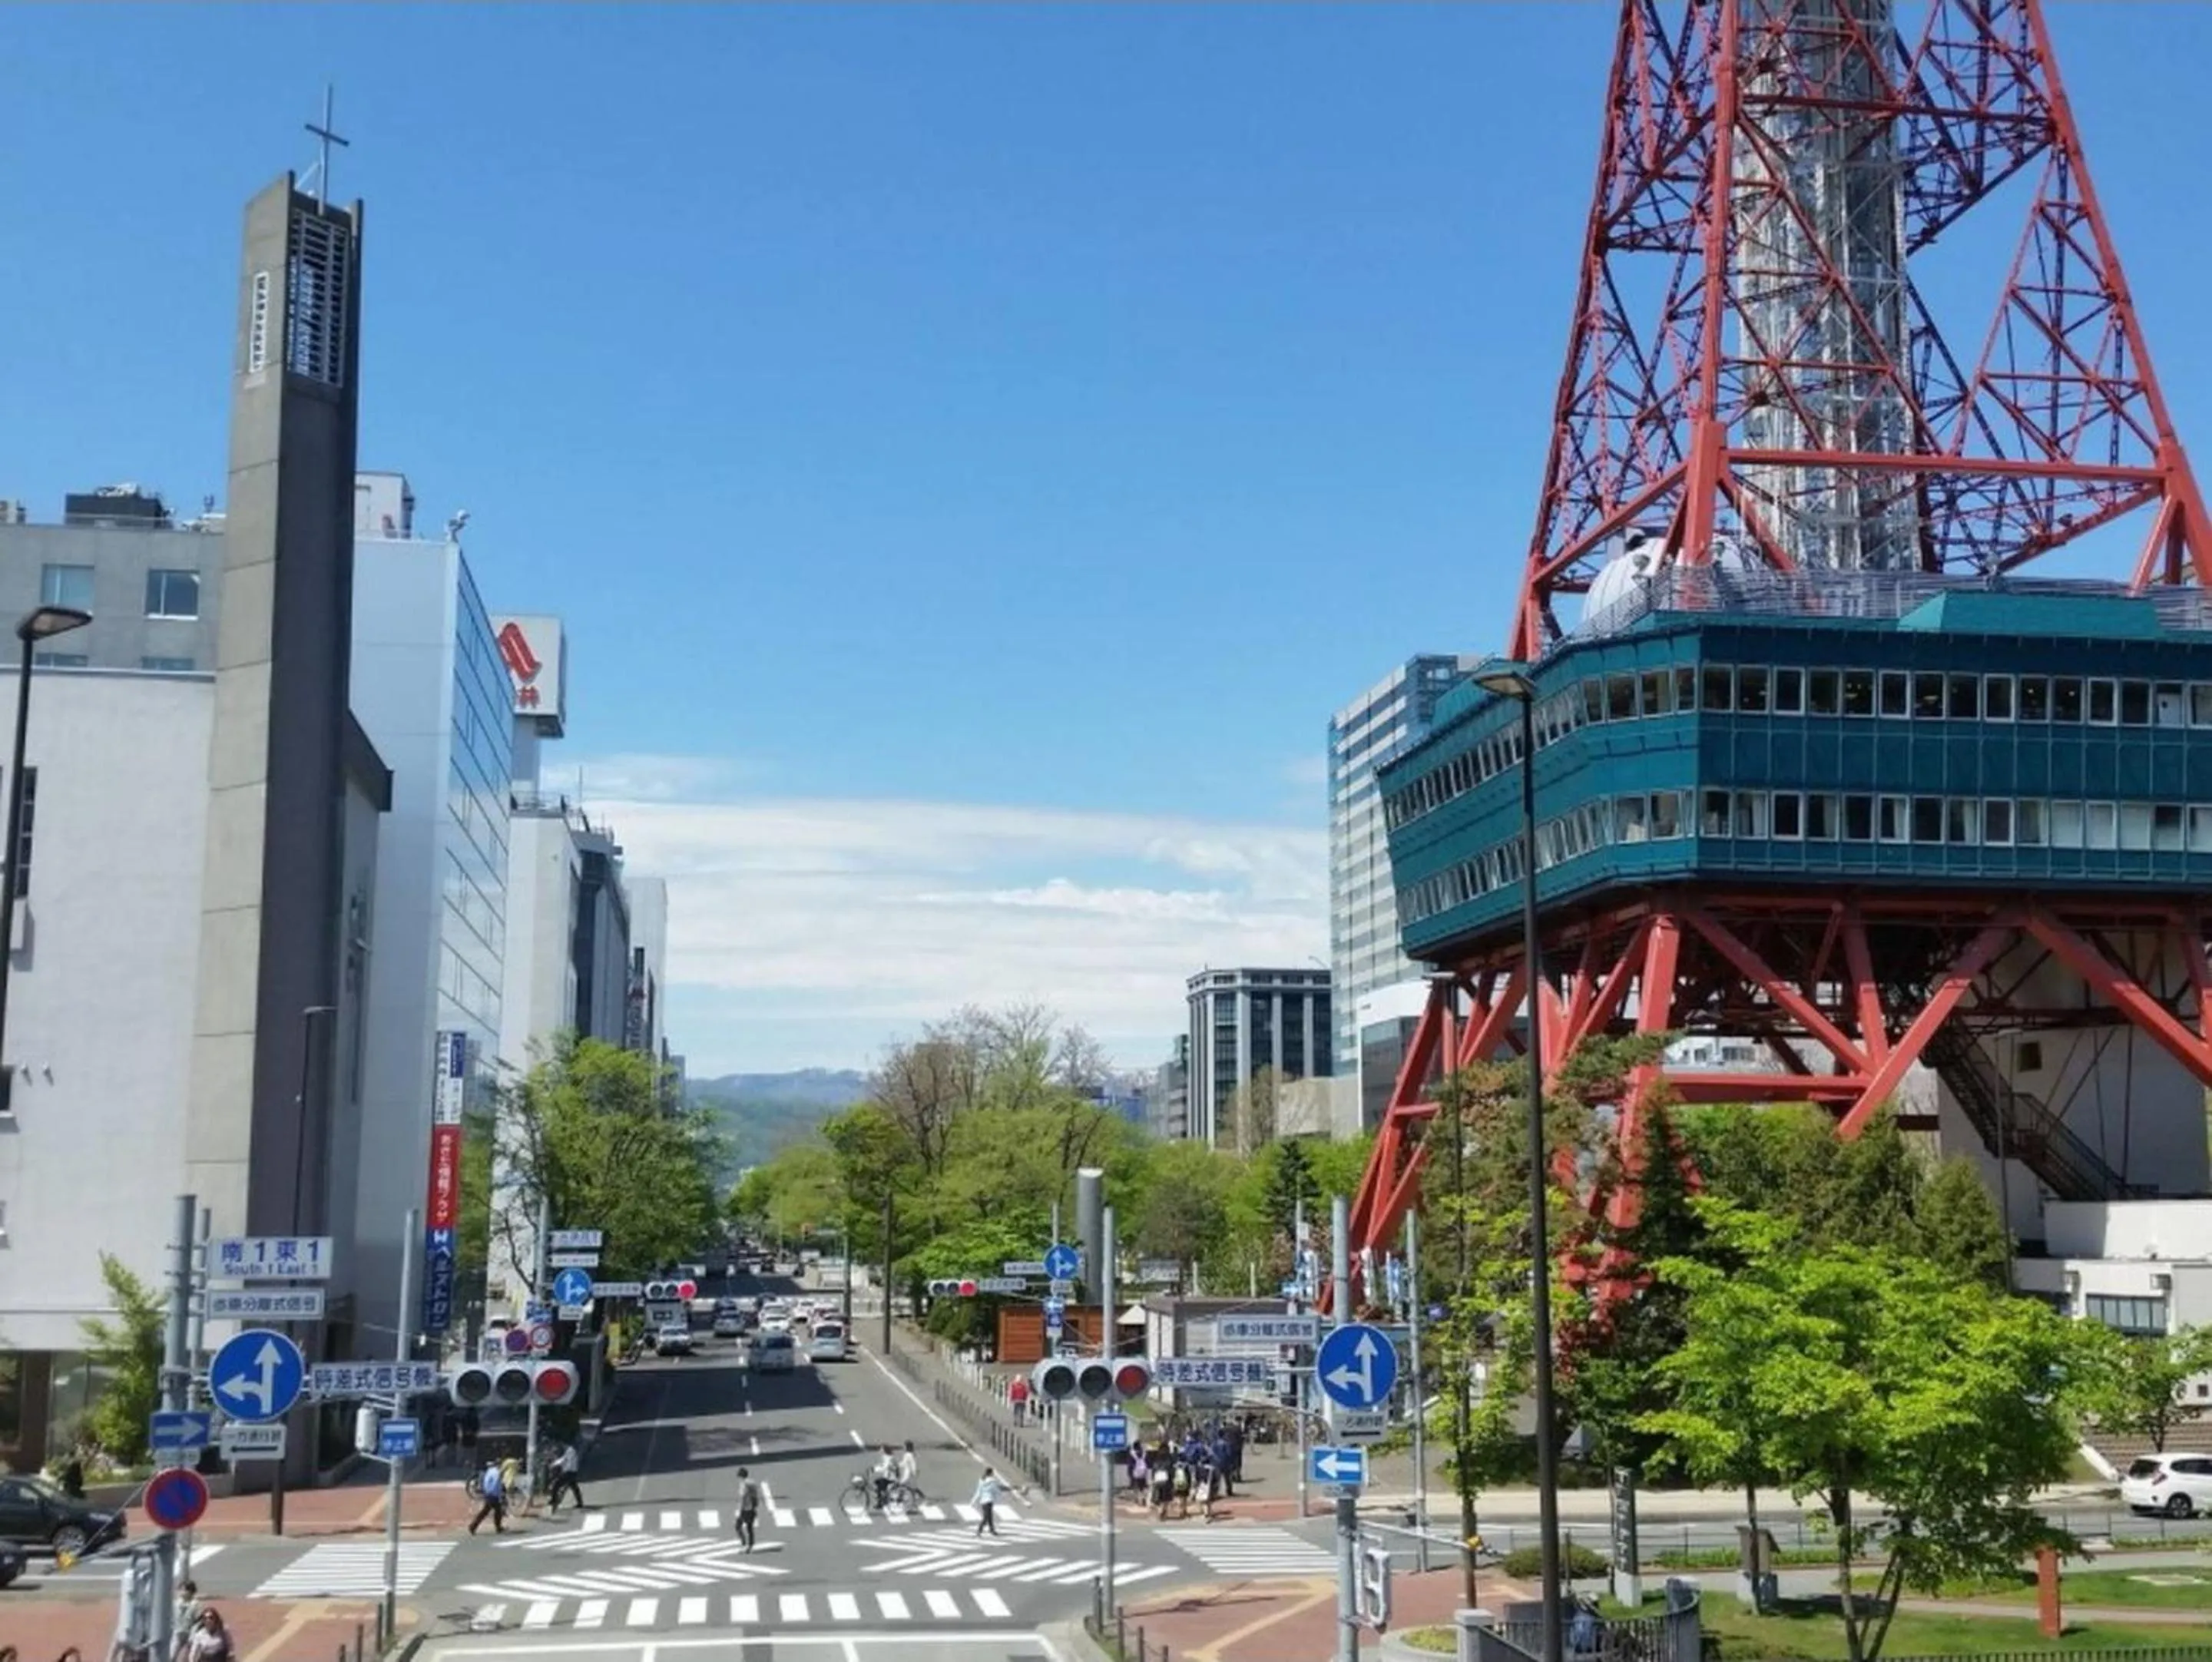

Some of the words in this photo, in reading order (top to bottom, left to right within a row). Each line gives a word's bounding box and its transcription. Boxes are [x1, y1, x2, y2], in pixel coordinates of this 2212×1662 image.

[314, 1366, 432, 1390] 時差式信号機
[1159, 1362, 1261, 1382] 時差式信号機
